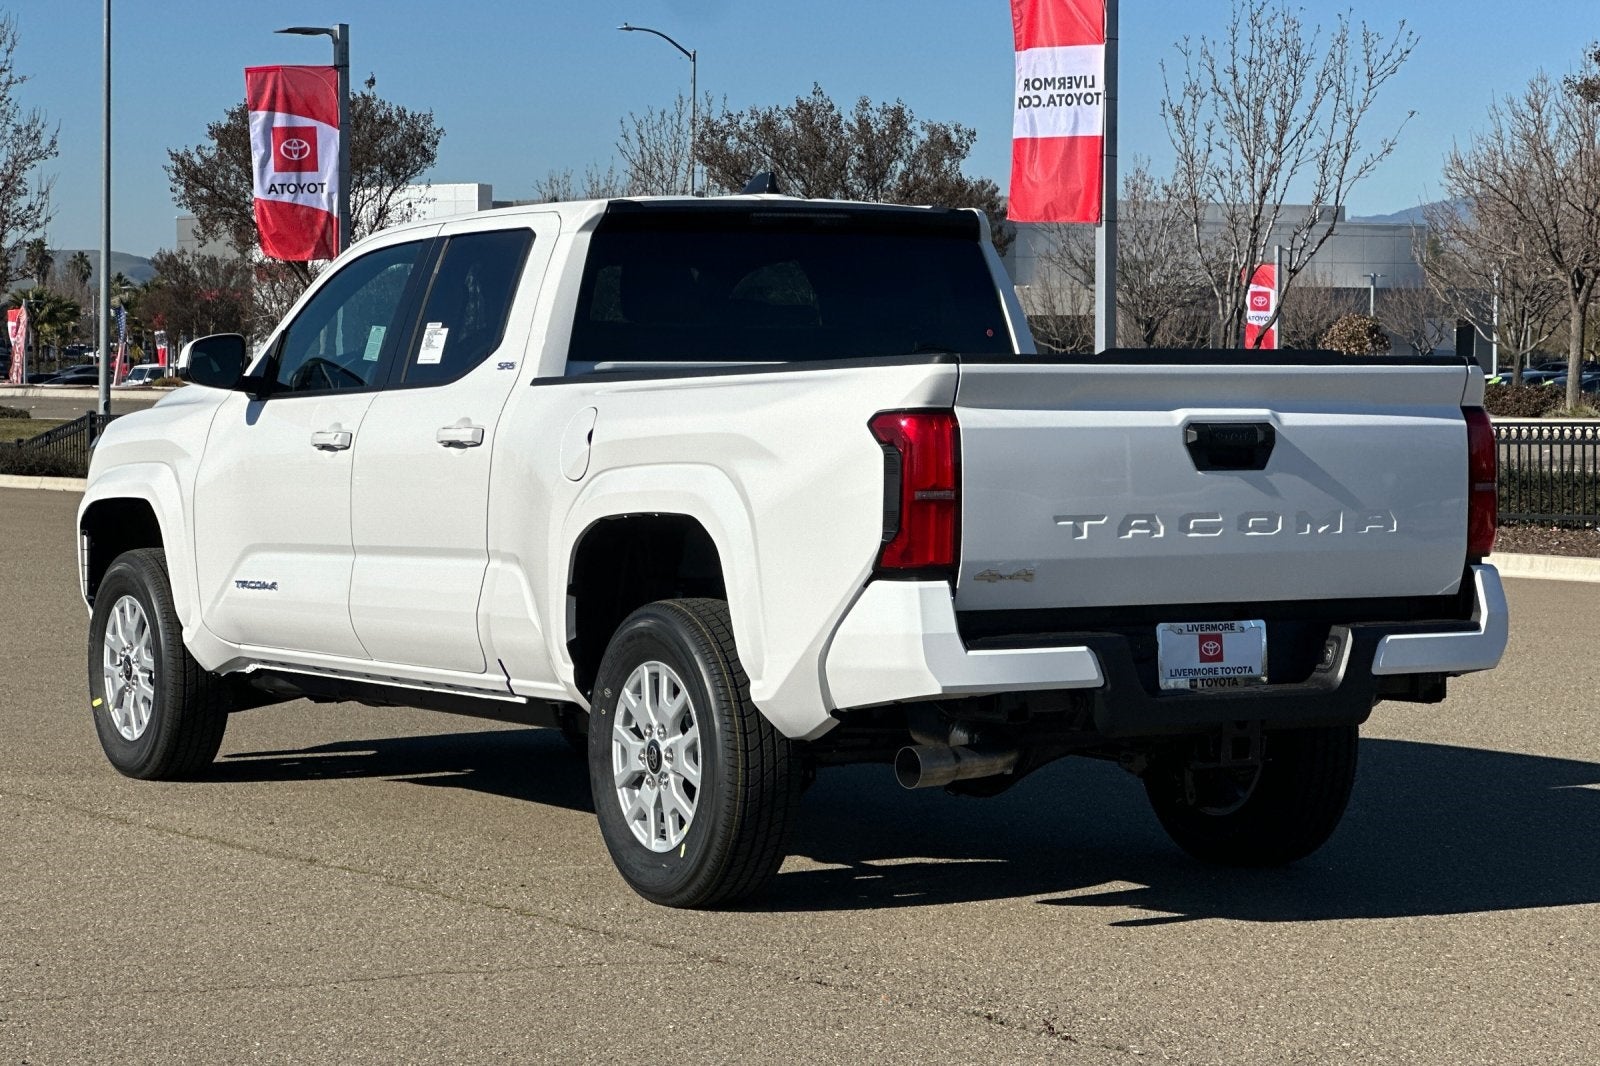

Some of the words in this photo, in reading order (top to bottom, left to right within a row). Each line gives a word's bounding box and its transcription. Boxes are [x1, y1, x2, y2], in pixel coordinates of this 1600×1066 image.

[1053, 511, 1397, 539] TACOMA
[235, 580, 278, 591] TACOMA
[1186, 623, 1235, 632] LIVERMORE
[1169, 667, 1219, 677] LIVERMORE
[1220, 666, 1254, 675] TOYOTA
[1200, 678, 1239, 688] TOYOTA
